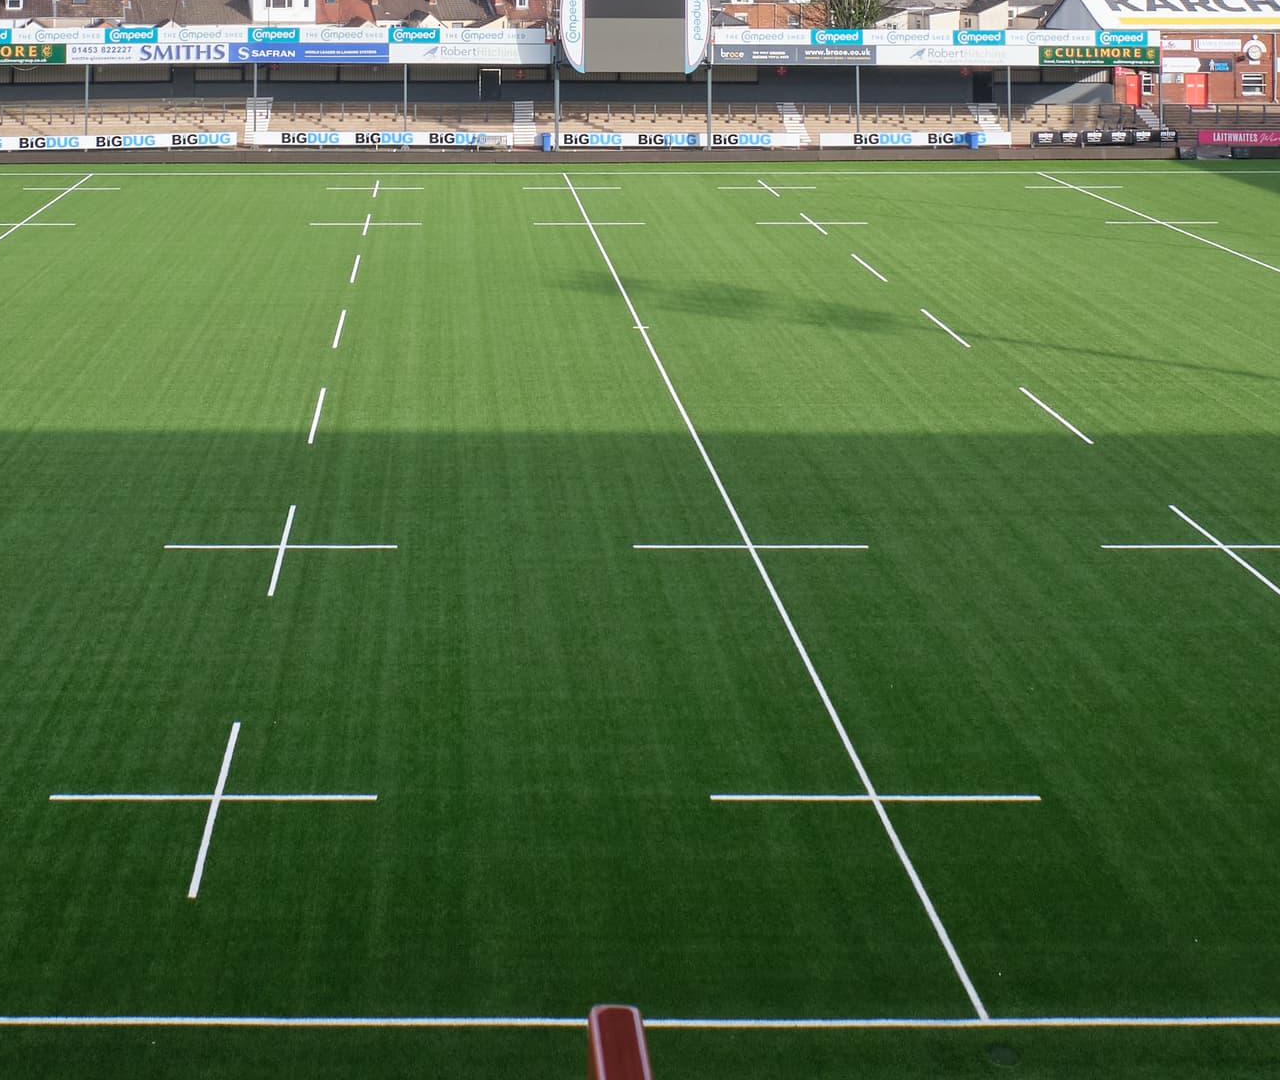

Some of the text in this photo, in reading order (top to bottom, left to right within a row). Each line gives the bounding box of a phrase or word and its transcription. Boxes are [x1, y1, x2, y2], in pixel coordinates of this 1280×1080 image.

[109, 29, 153, 42] Compeed
[252, 29, 295, 42] Compeed
[393, 29, 436, 41] Compeed
[816, 31, 858, 44] Compeed
[958, 31, 1001, 44] Compeed
[1099, 31, 1144, 45] Compeed
[72, 46, 98, 54] 01453
[140, 45, 226, 61] SMITHS
[252, 50, 296, 58] SAFRAN
[1056, 48, 1141, 58] CULLIMORE
[1213, 132, 1258, 143] LAITHWAITES
